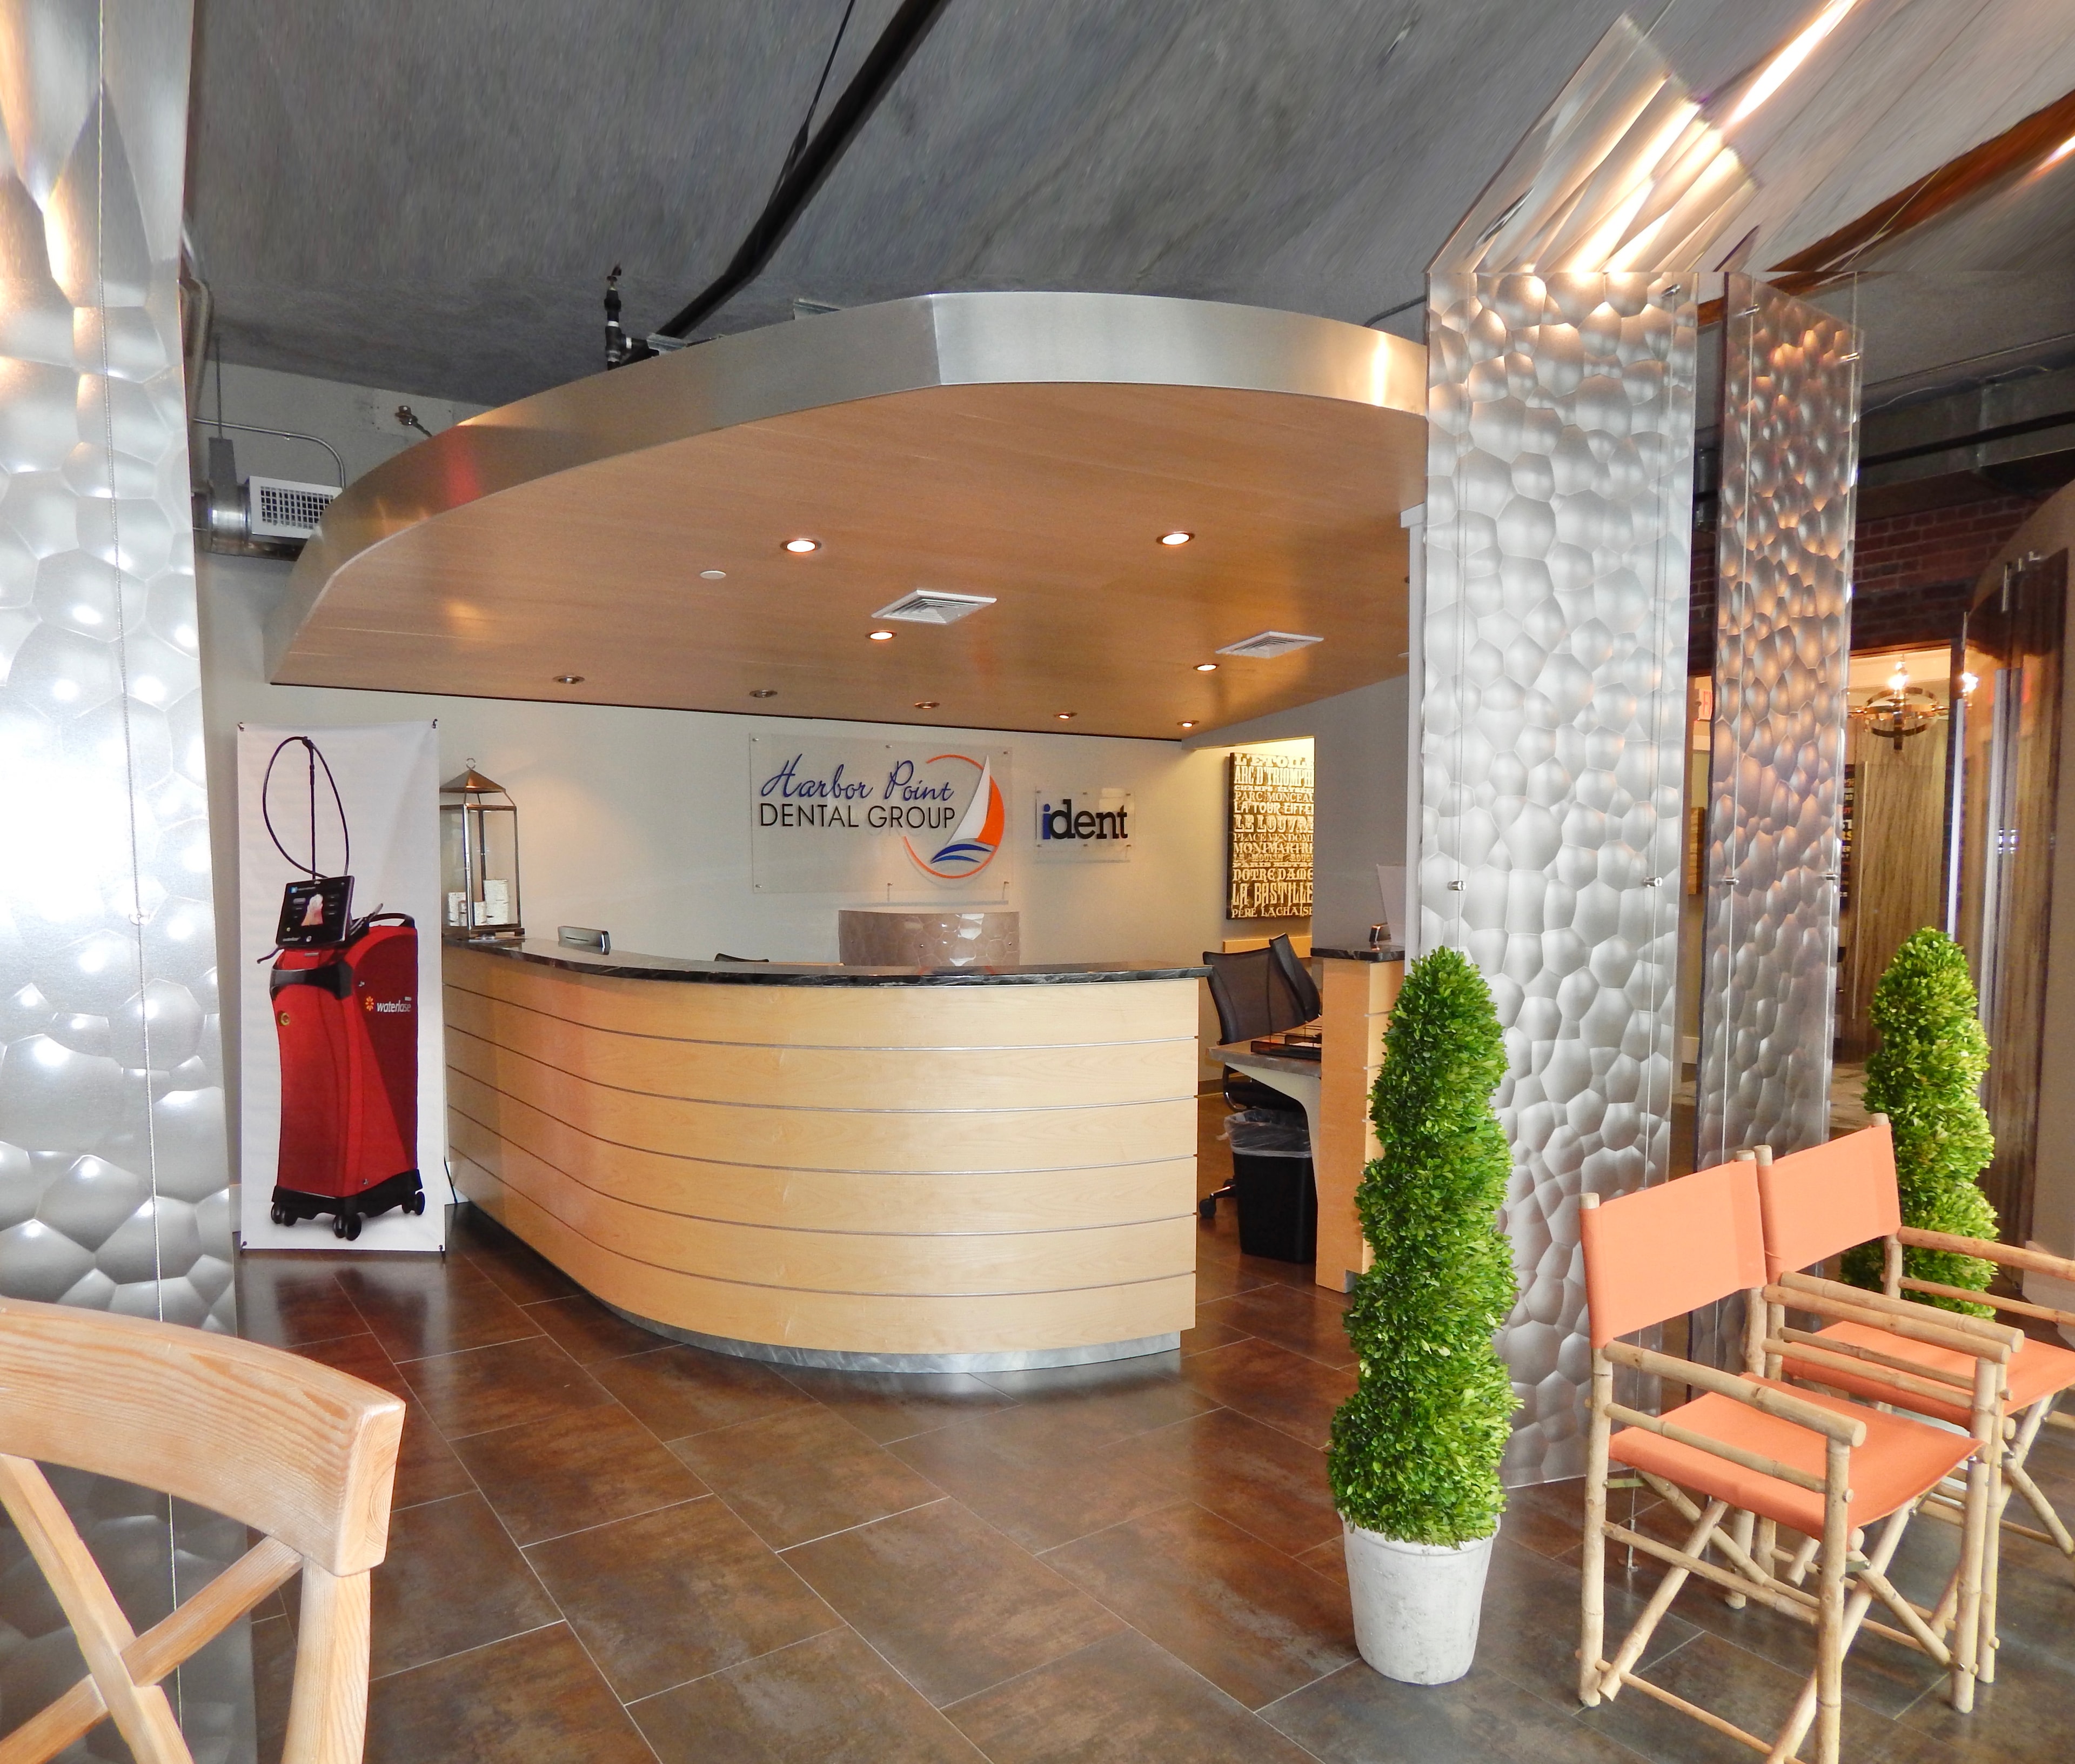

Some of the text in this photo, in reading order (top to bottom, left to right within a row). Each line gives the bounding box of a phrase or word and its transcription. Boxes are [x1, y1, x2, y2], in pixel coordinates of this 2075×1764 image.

[761, 753, 954, 801] Harbor Point
[1234, 765, 1254, 785] ARC
[1234, 791, 1263, 801] PARC
[760, 803, 955, 828] DENTAL GROUP
[1234, 801, 1249, 813] LA
[1253, 801, 1281, 815] TOUR
[1043, 799, 1128, 839] ident
[1234, 814, 1314, 833] LE LOUVRE
[1234, 833, 1266, 841] PLACE
[1233, 868, 1314, 881] NOTRE DAME
[1233, 882, 1313, 906] LA BASTILLE
